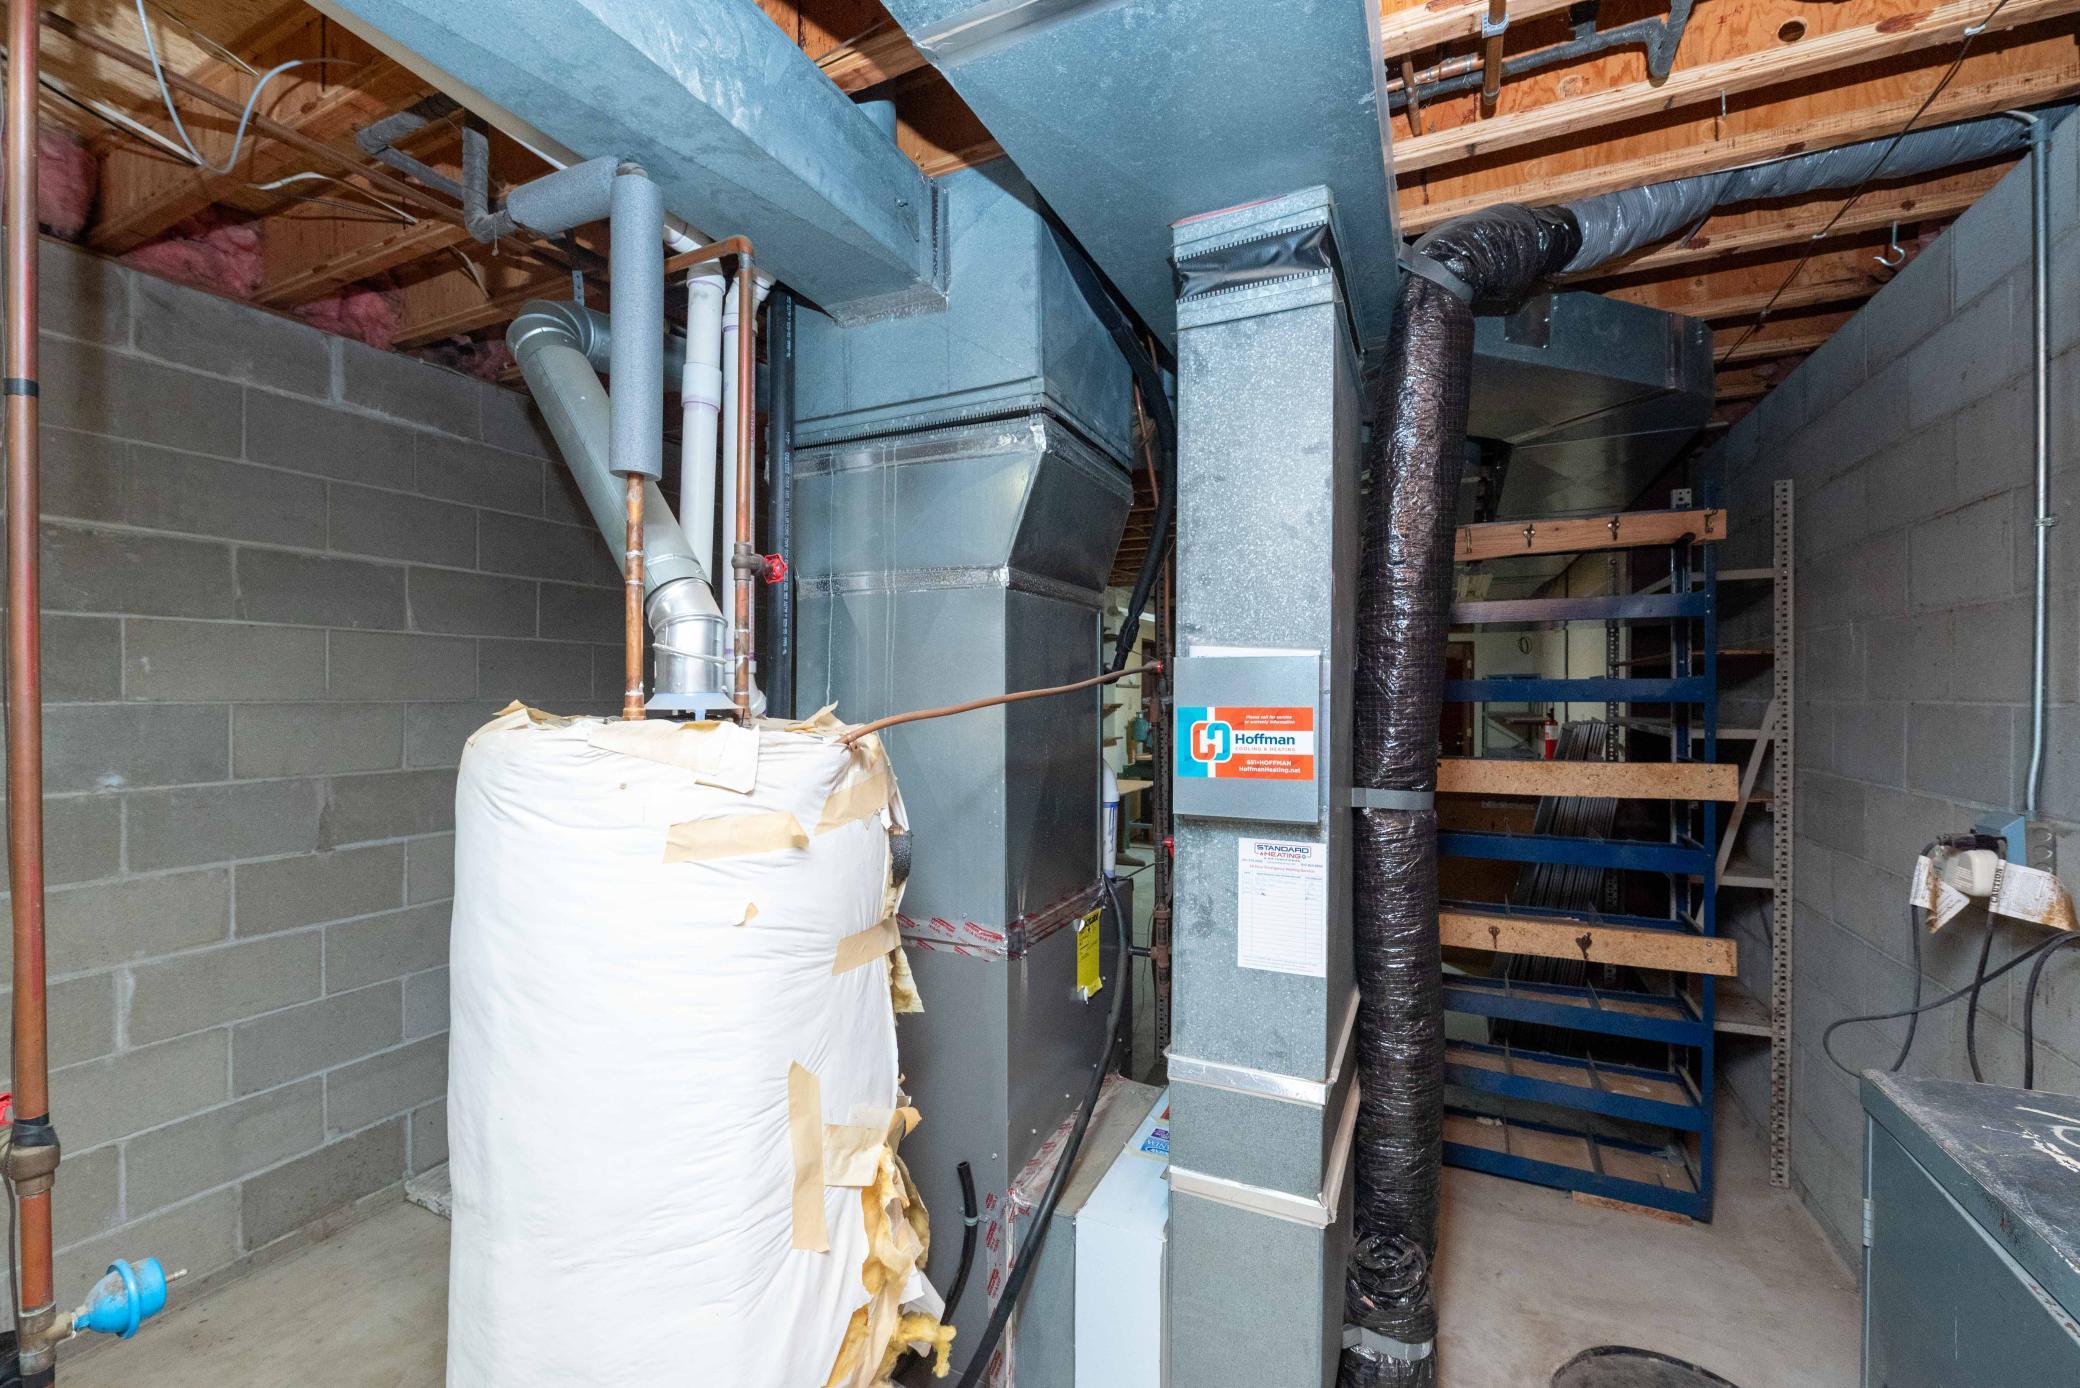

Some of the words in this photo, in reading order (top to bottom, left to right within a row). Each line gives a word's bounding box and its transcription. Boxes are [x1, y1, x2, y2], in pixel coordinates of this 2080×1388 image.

[1235, 733, 1295, 745] Hoffman
[1257, 844, 1309, 853] STANDARD
[1991, 867, 2003, 903] CAUTION
